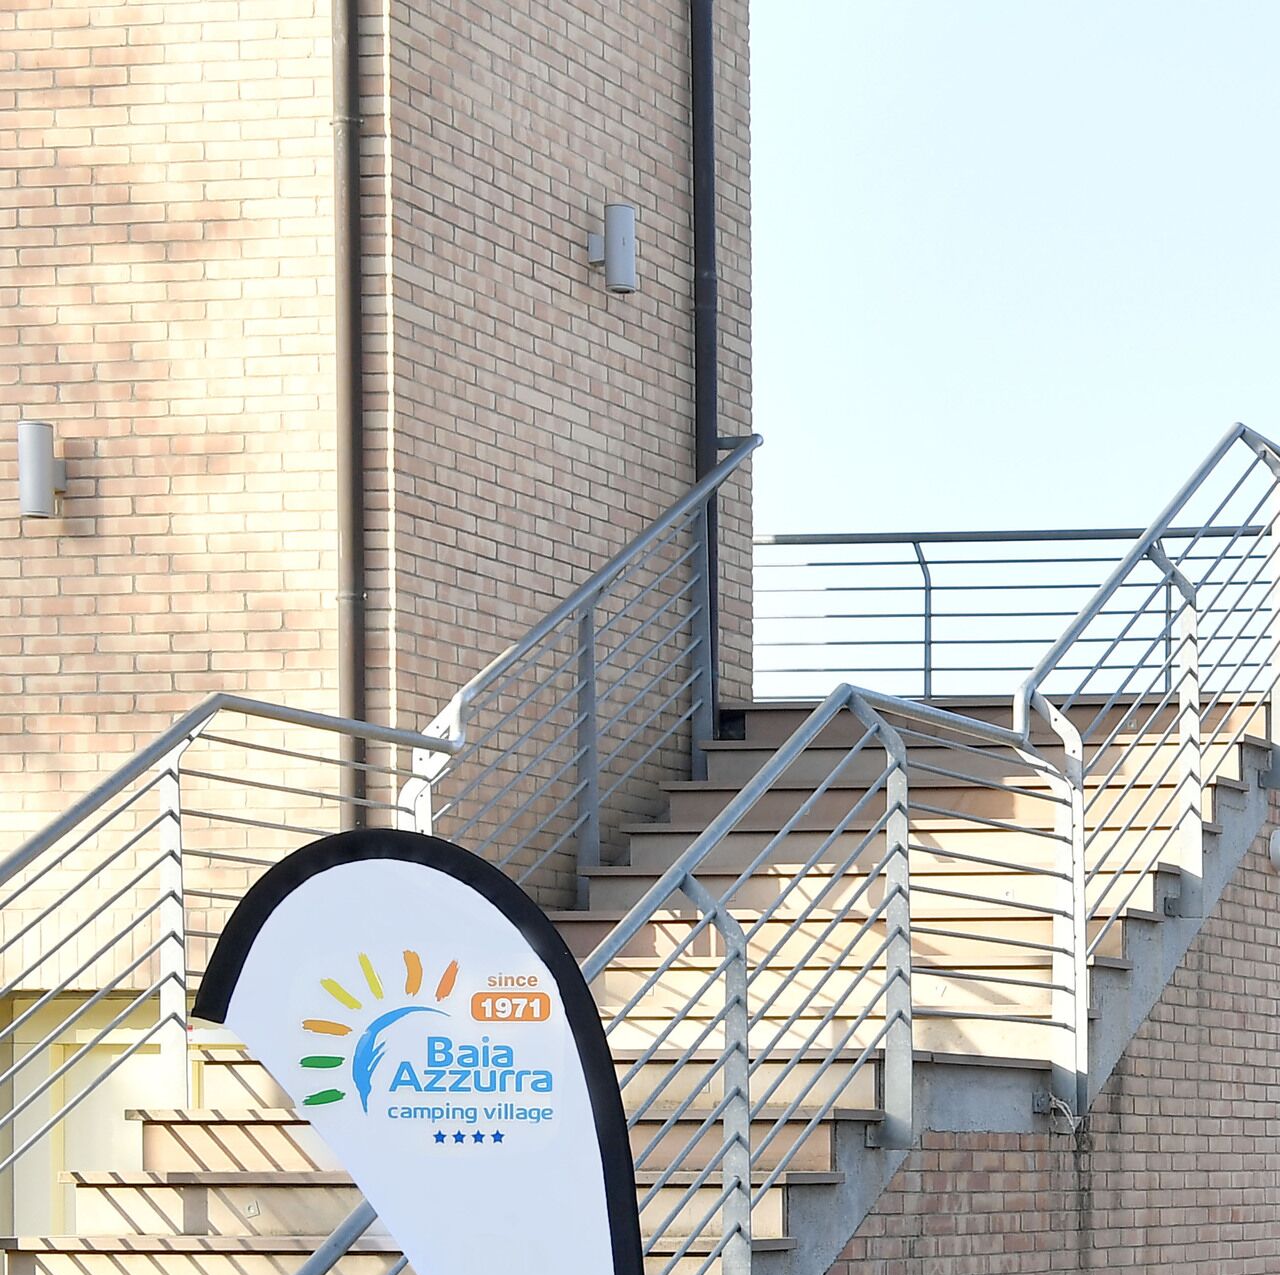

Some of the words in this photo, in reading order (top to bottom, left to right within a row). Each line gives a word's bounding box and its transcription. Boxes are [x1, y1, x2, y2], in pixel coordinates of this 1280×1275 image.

[487, 972, 538, 988] since
[480, 997, 542, 1019] 1971
[427, 1036, 514, 1068] Baia
[388, 1061, 553, 1093] Azzurra
[387, 1104, 478, 1124] camping
[482, 1103, 554, 1124] village
